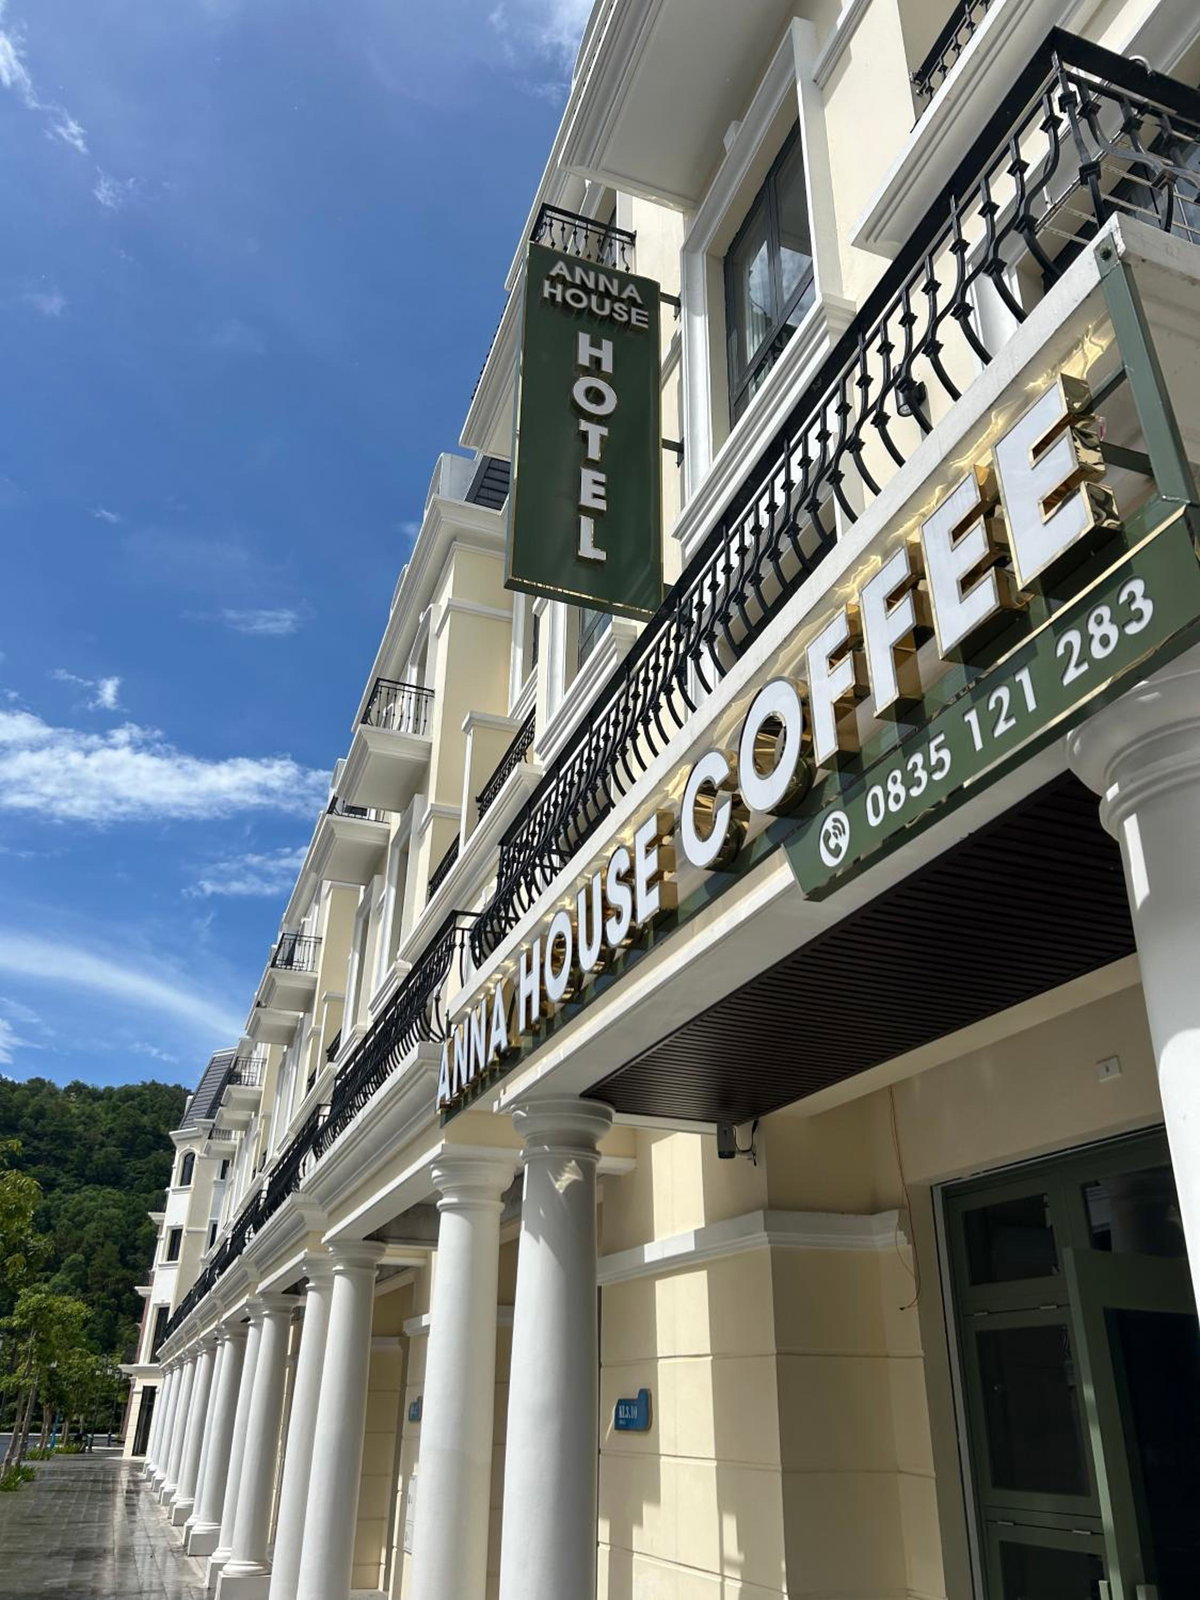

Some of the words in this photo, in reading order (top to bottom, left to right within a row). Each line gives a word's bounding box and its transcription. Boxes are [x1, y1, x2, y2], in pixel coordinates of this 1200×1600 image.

[542, 279, 650, 330] HOUSE
[549, 259, 644, 305] ANNA
[572, 331, 618, 562] HOTEL
[436, 978, 509, 1113] ANNA
[518, 812, 661, 1036] HOUSE
[680, 374, 1098, 867] COFFEE
[866, 733, 951, 827] 0835
[964, 666, 1038, 752] 121
[1056, 578, 1154, 687] 283
